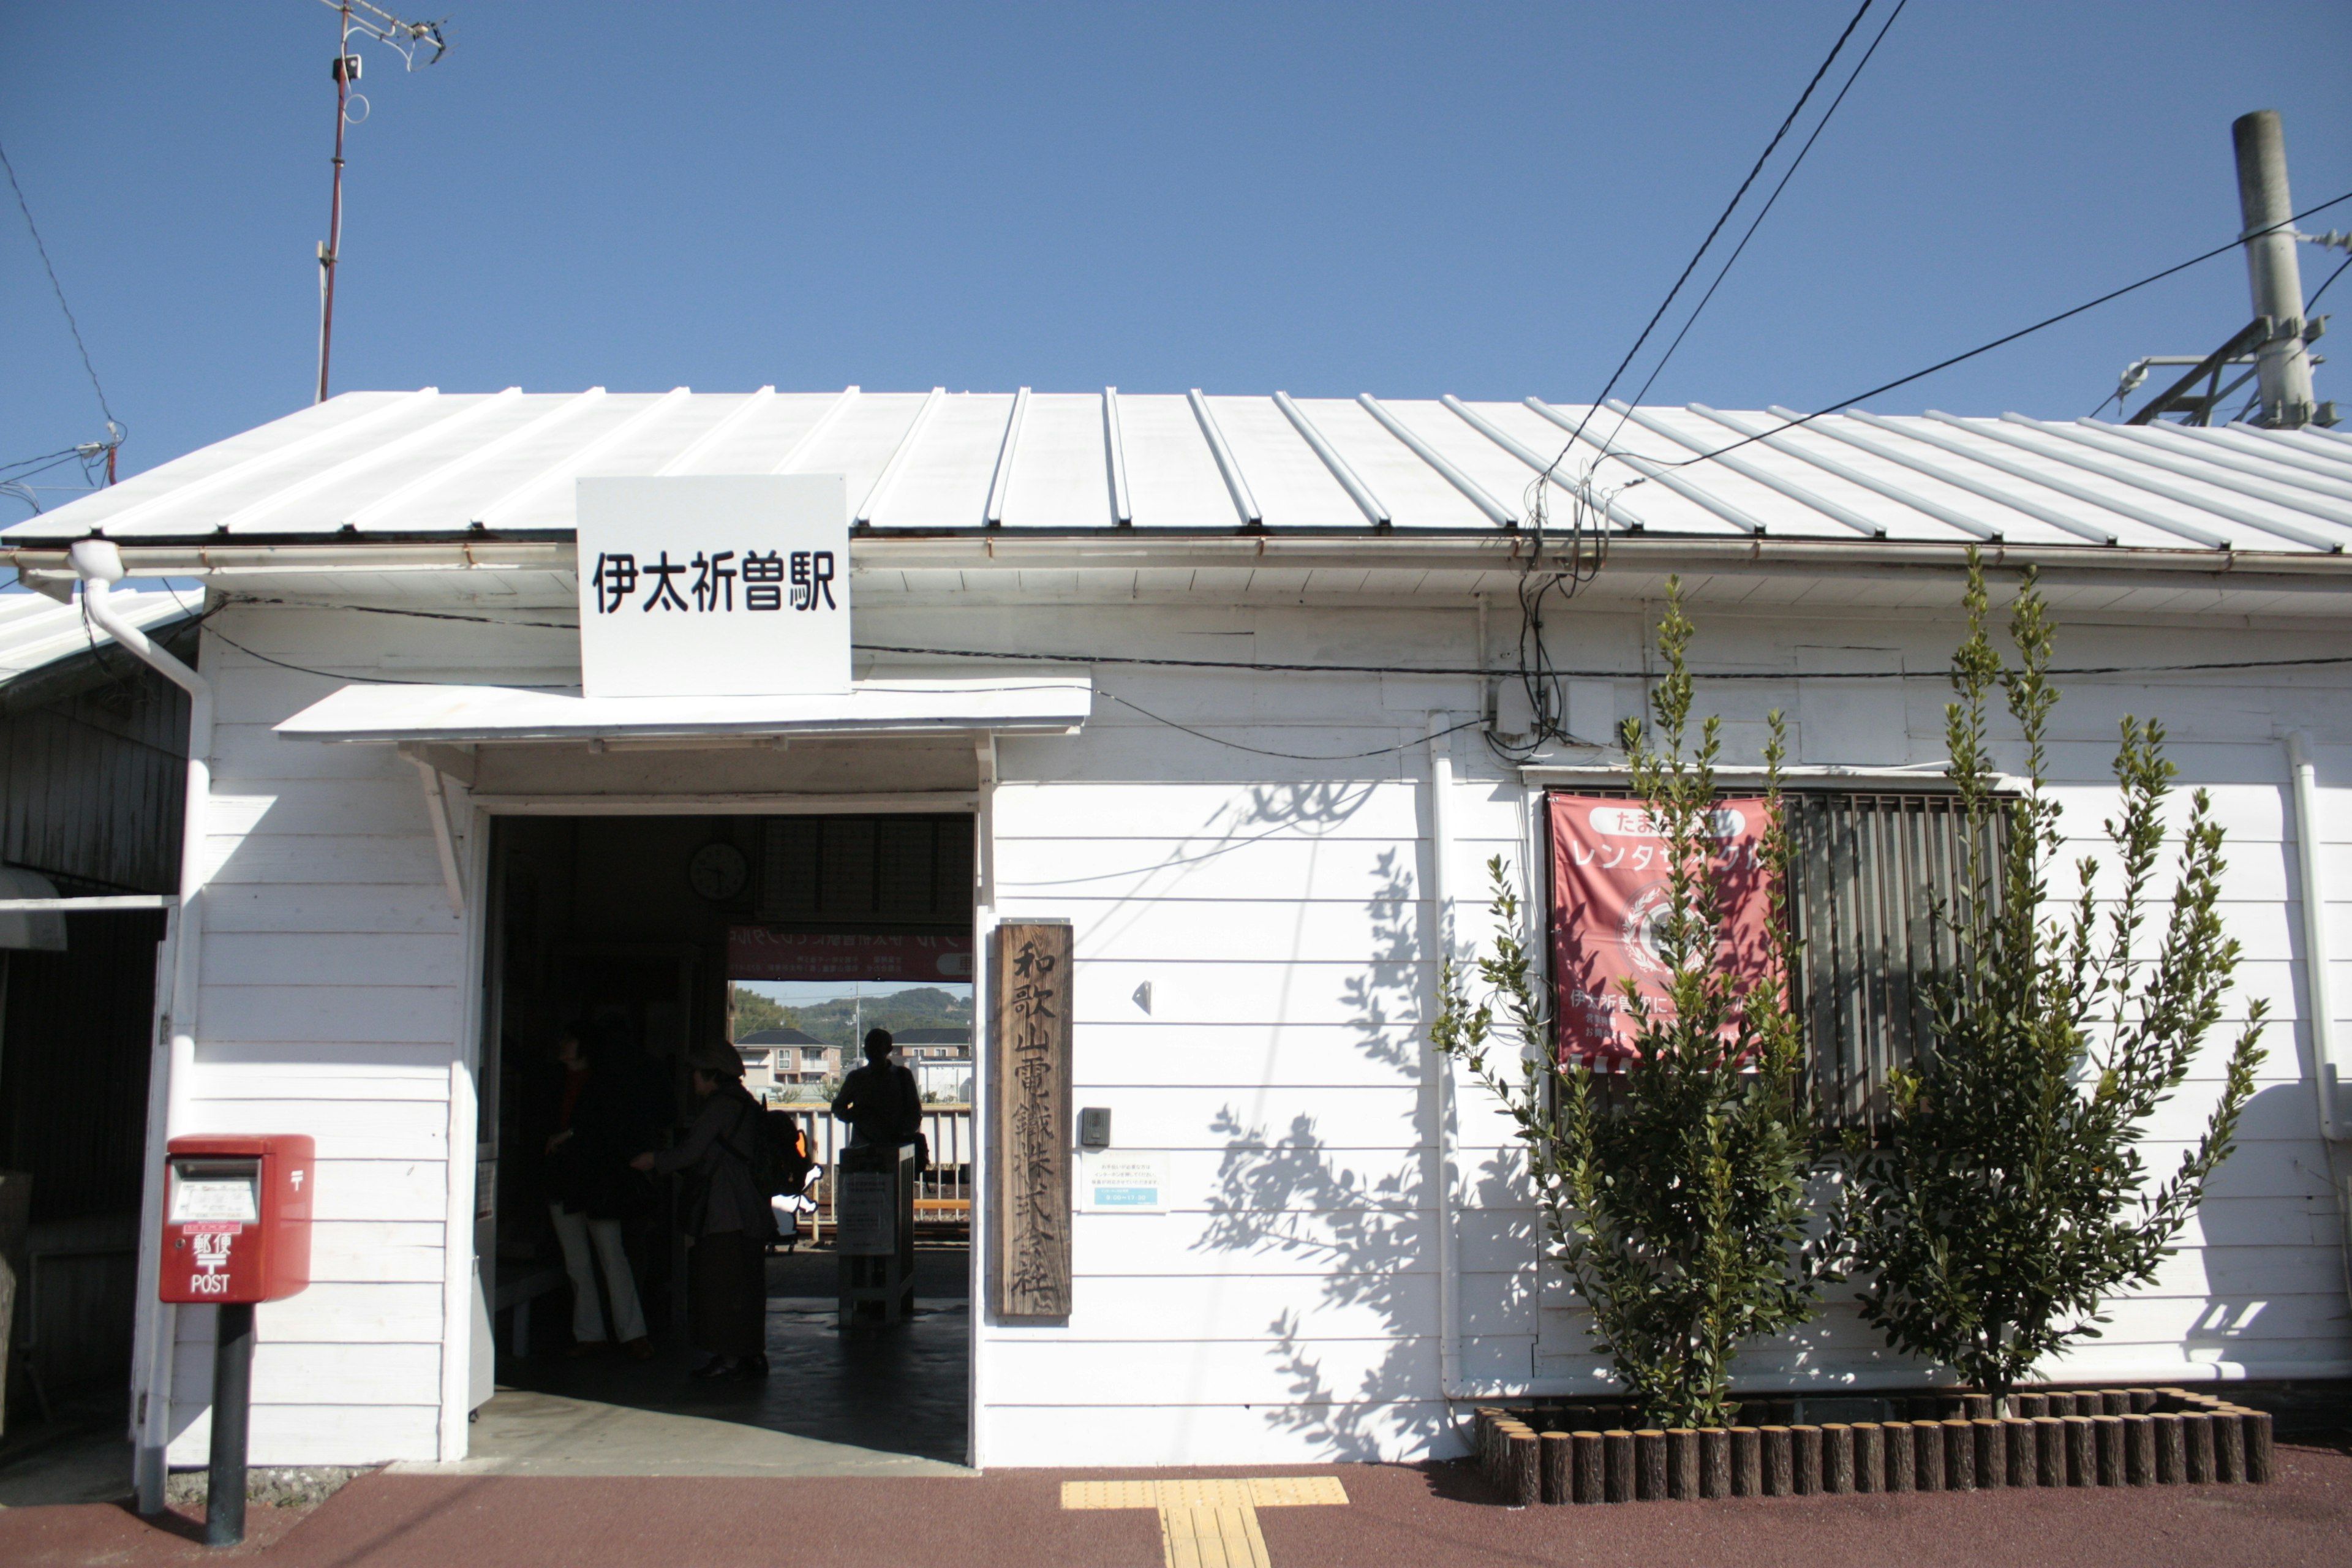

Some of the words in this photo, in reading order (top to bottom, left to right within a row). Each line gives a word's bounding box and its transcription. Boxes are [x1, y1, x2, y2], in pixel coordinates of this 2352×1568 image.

[592, 550, 837, 614] 伊太祈曽駅
[193, 1233, 232, 1255] 郵便
[190, 1274, 230, 1294] POST
